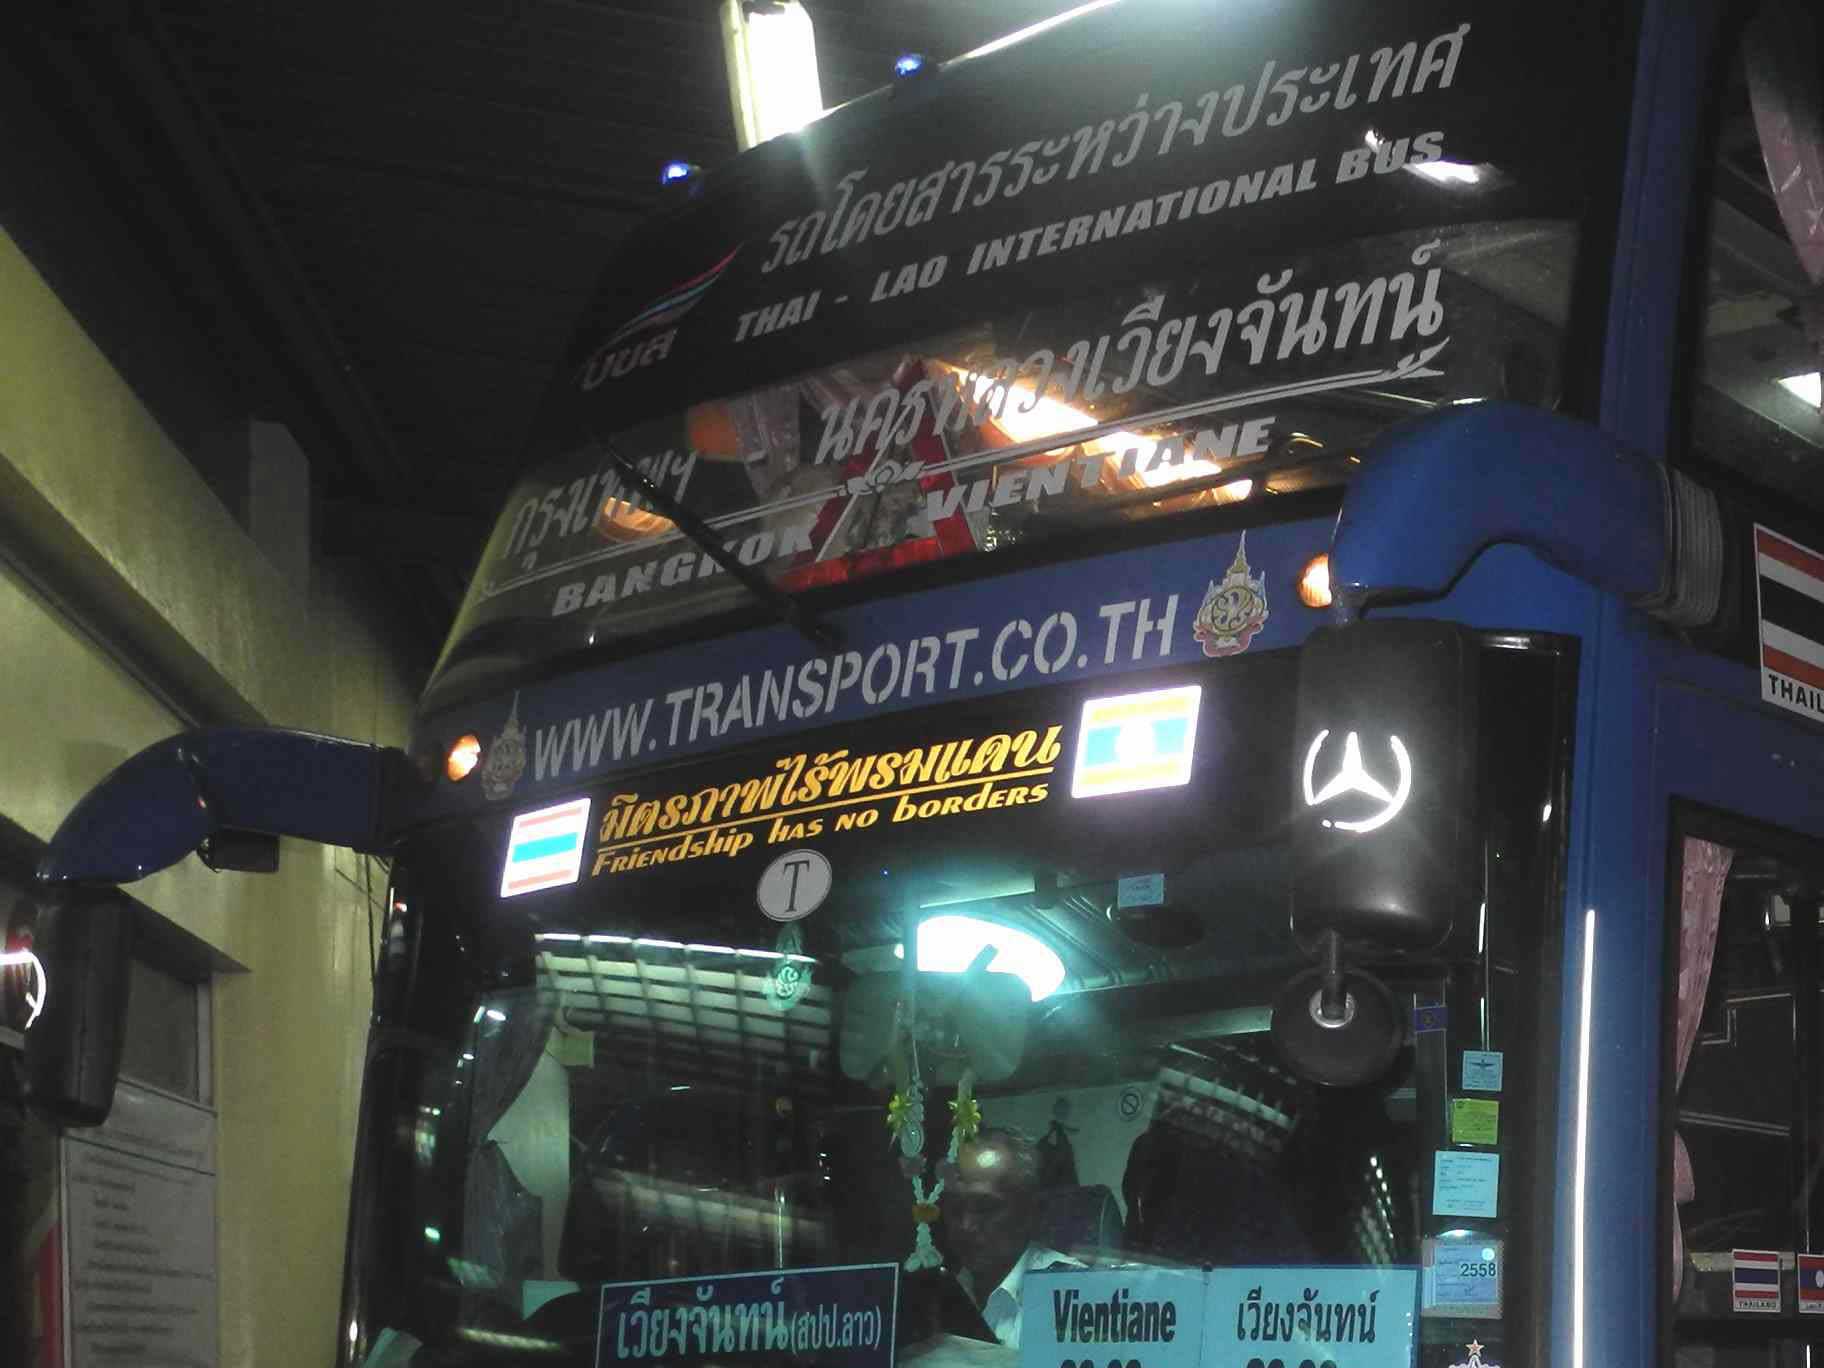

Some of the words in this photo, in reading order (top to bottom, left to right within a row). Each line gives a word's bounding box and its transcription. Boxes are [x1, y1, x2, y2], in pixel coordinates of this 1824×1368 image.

[761, 23, 1471, 275] รถโดยสารระหว่างประเทศ
[733, 290, 821, 342] THAI
[871, 254, 945, 303] LAO
[966, 154, 1317, 276] INTERNATIONAL
[1335, 131, 1445, 183] BUS
[927, 415, 1276, 521] VIENTIANE
[532, 594, 1180, 783] WWW.TRANSPORT.CO.TH
[600, 724, 1064, 843] มิตรภาพไร้พรมแดน
[1053, 1288, 1177, 1343] Vientiane
[1236, 1285, 1381, 1344] เวียงจันทน์
[1460, 1262, 1497, 1278] 2558
